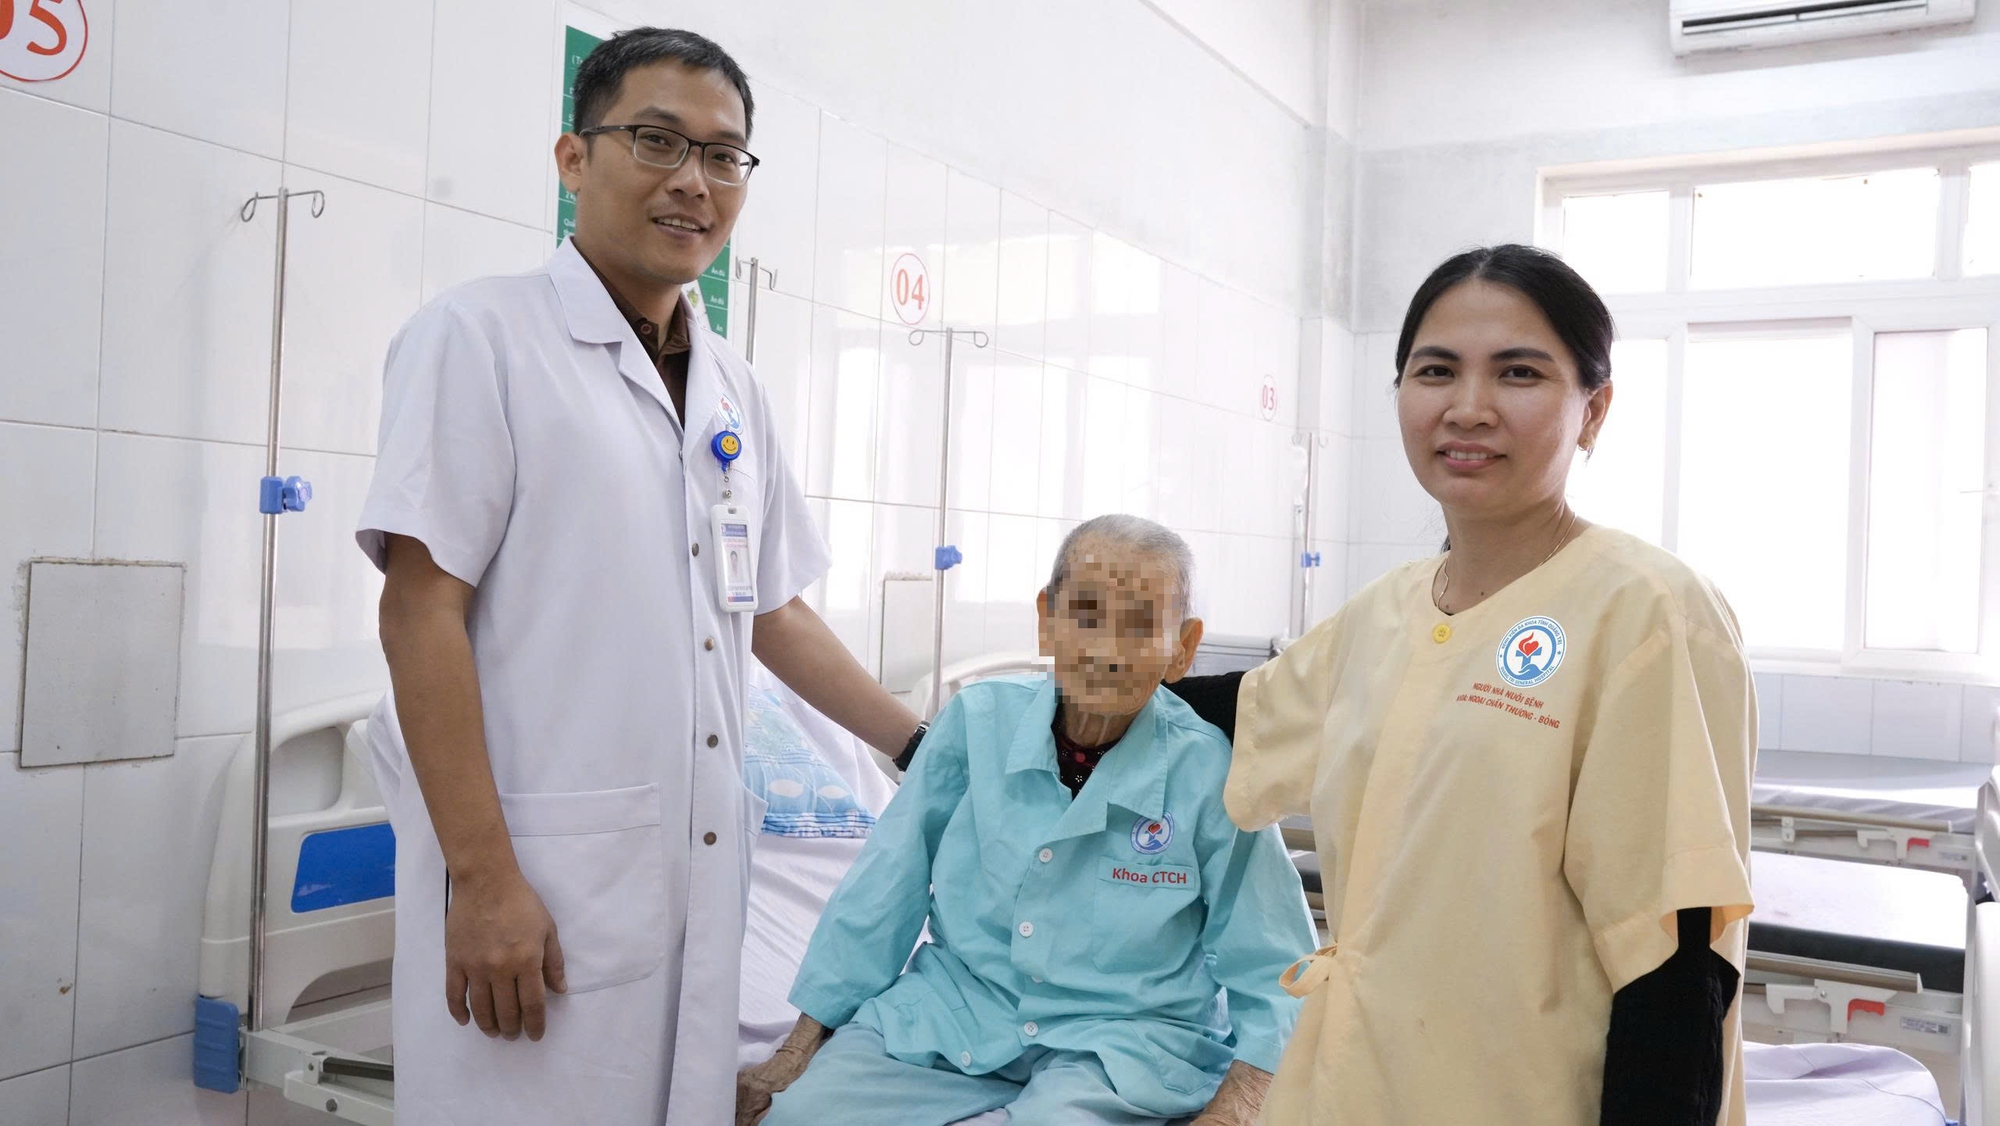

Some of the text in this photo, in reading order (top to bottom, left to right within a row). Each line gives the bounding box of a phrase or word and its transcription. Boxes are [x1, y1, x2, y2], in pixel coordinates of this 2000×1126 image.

[896, 268, 924, 310] 04
[1262, 384, 1275, 411] 03
[1524, 696, 1544, 709] BỆNH
[1538, 714, 1560, 729] BỎNG
[1112, 867, 1187, 884] Khoa CTCH
